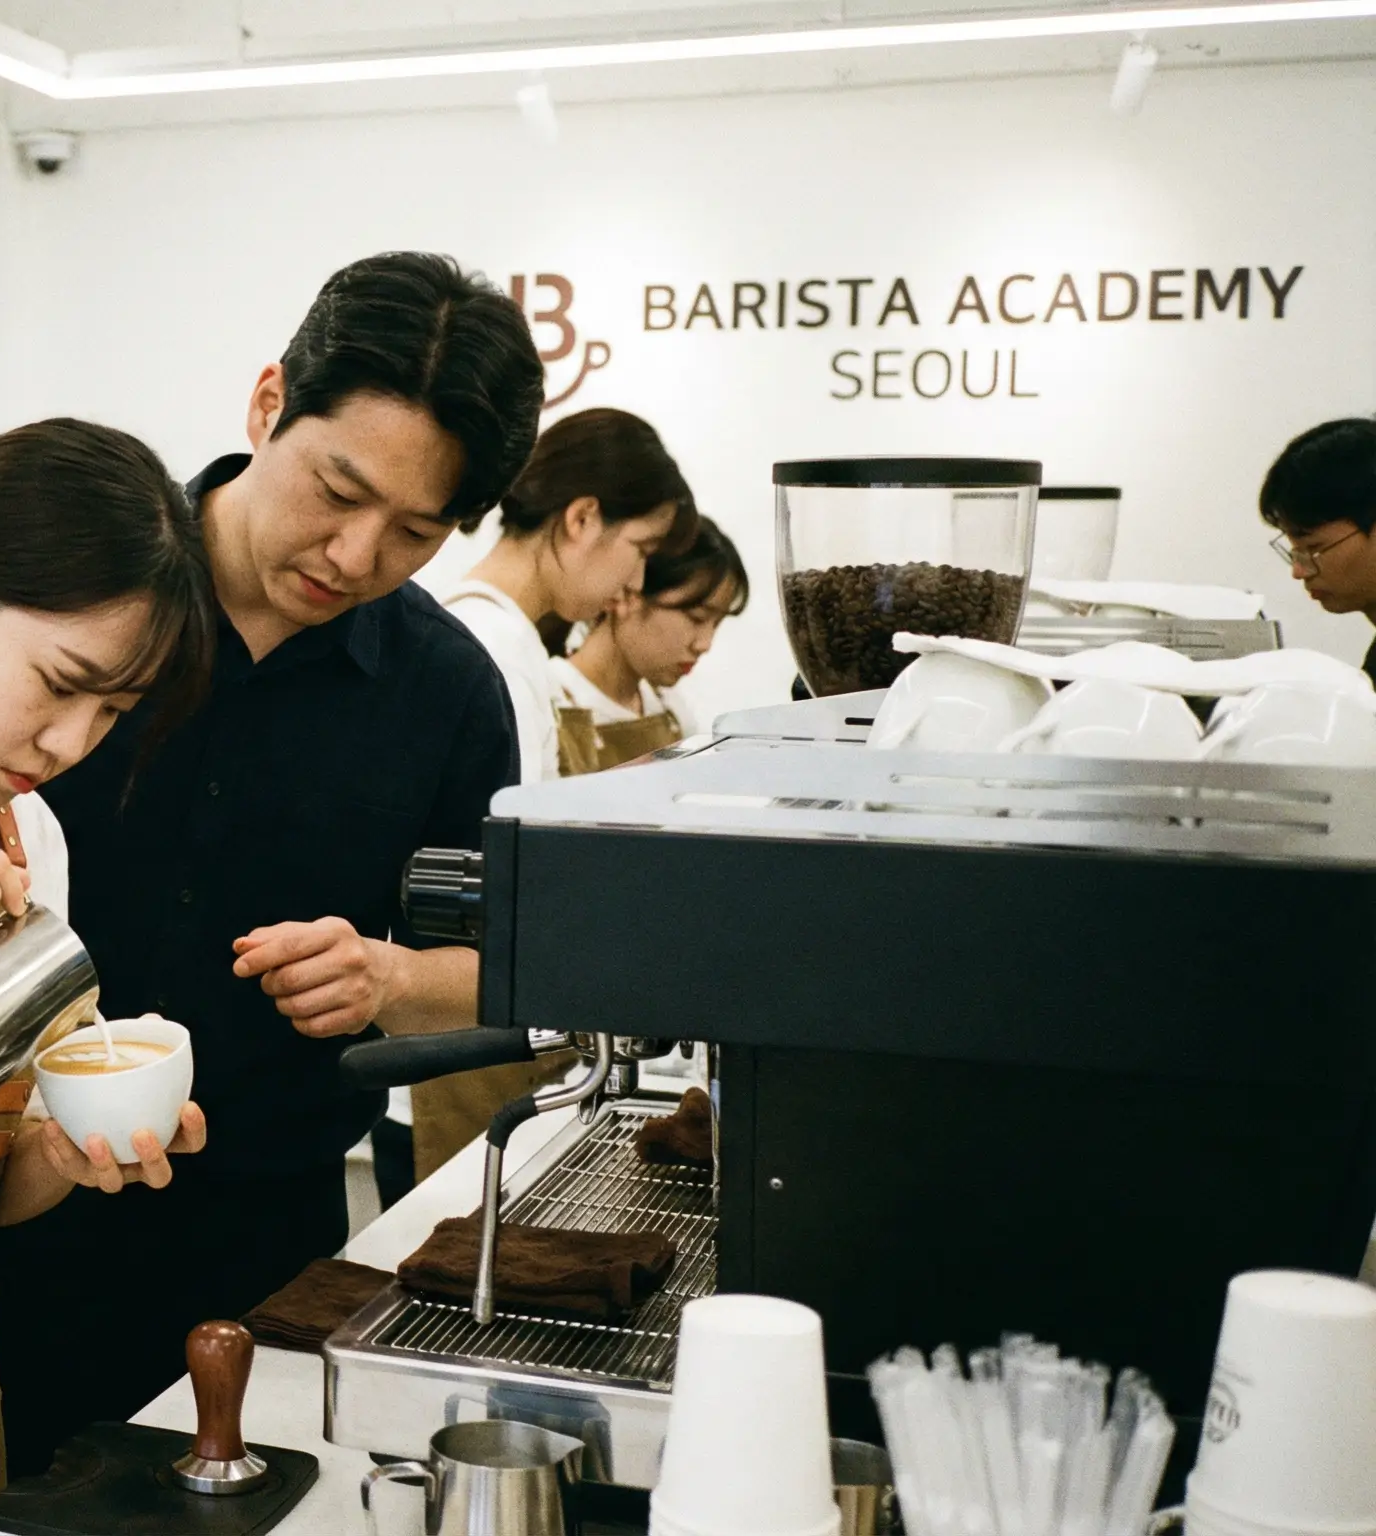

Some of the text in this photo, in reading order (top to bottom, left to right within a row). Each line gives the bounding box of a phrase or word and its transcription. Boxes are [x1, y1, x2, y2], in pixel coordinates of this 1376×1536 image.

[643, 265, 1304, 331] BARISTA ACADEMY
[830, 349, 1039, 400] SEOUL
